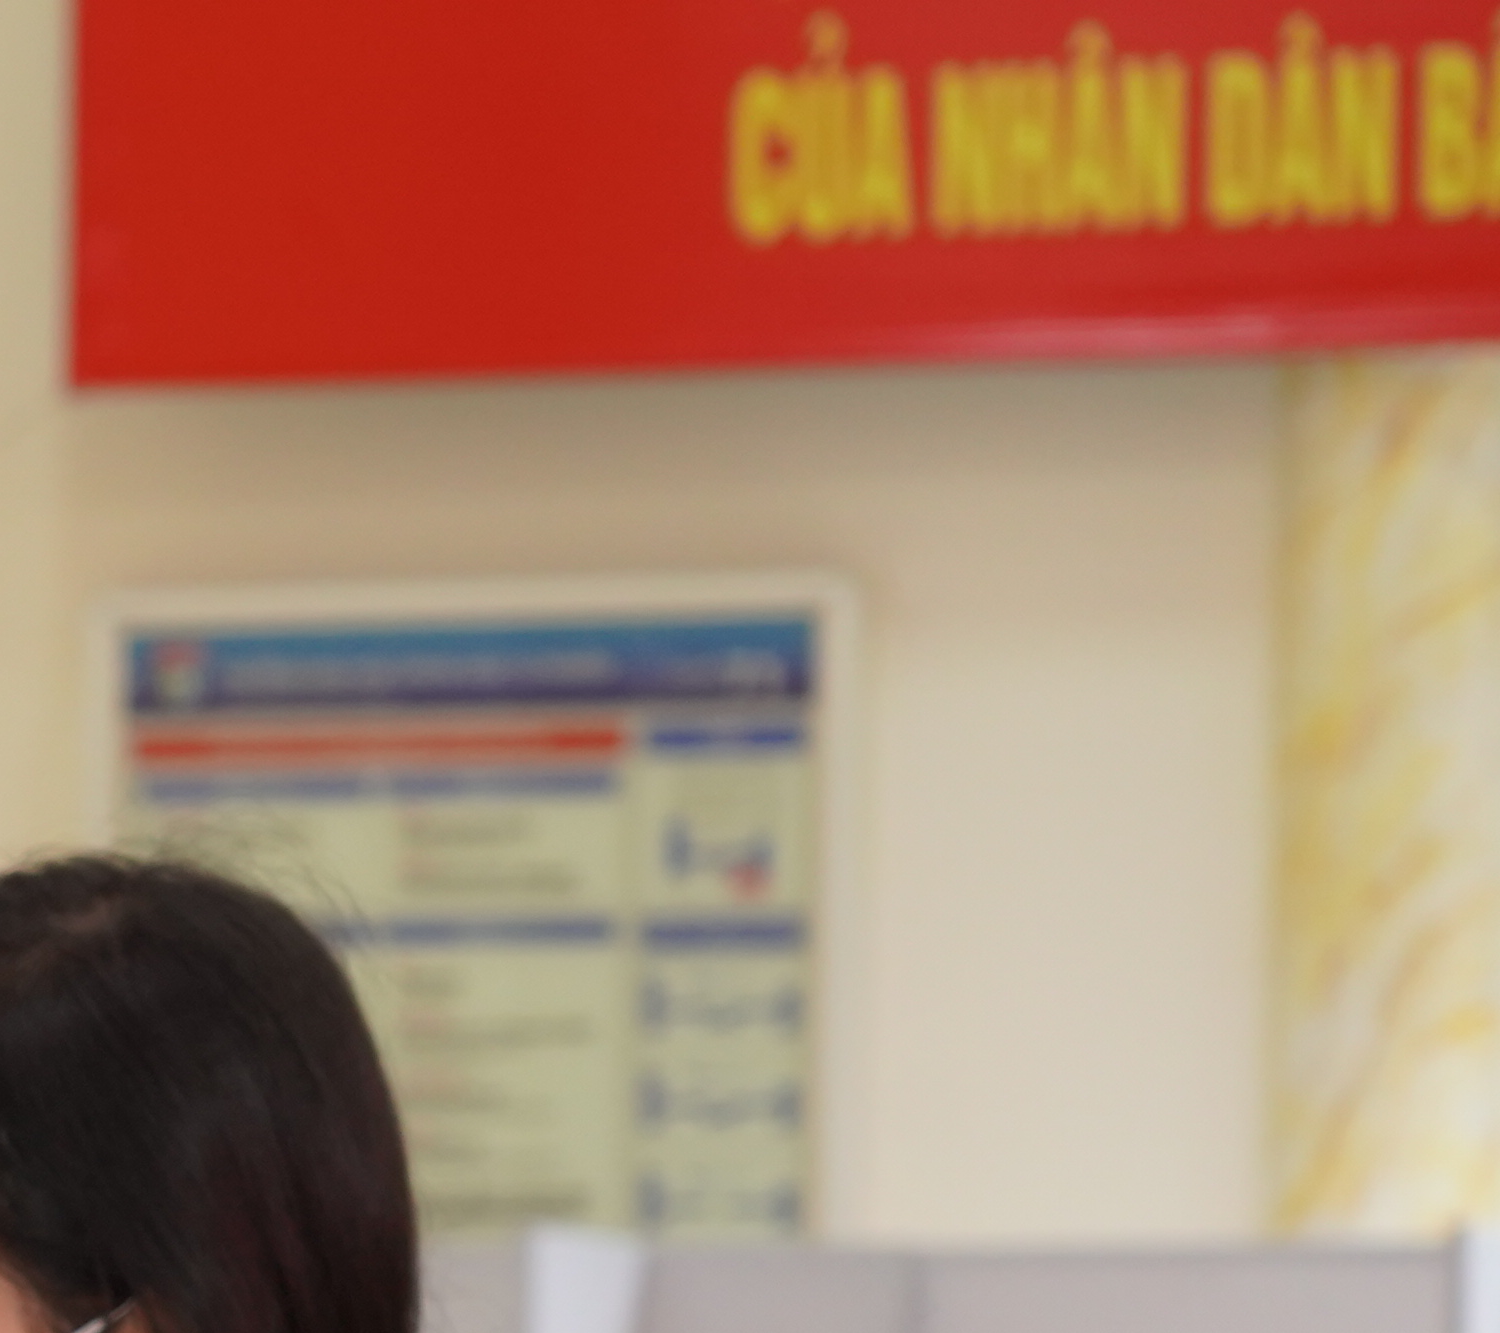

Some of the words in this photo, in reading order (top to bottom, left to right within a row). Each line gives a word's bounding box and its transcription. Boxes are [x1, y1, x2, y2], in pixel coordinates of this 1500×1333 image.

[729, 12, 916, 244] CỦA
[928, 20, 1190, 236] NHÂN
[1203, 11, 1401, 229] DÂN
[1415, 10, 1500, 220] B
